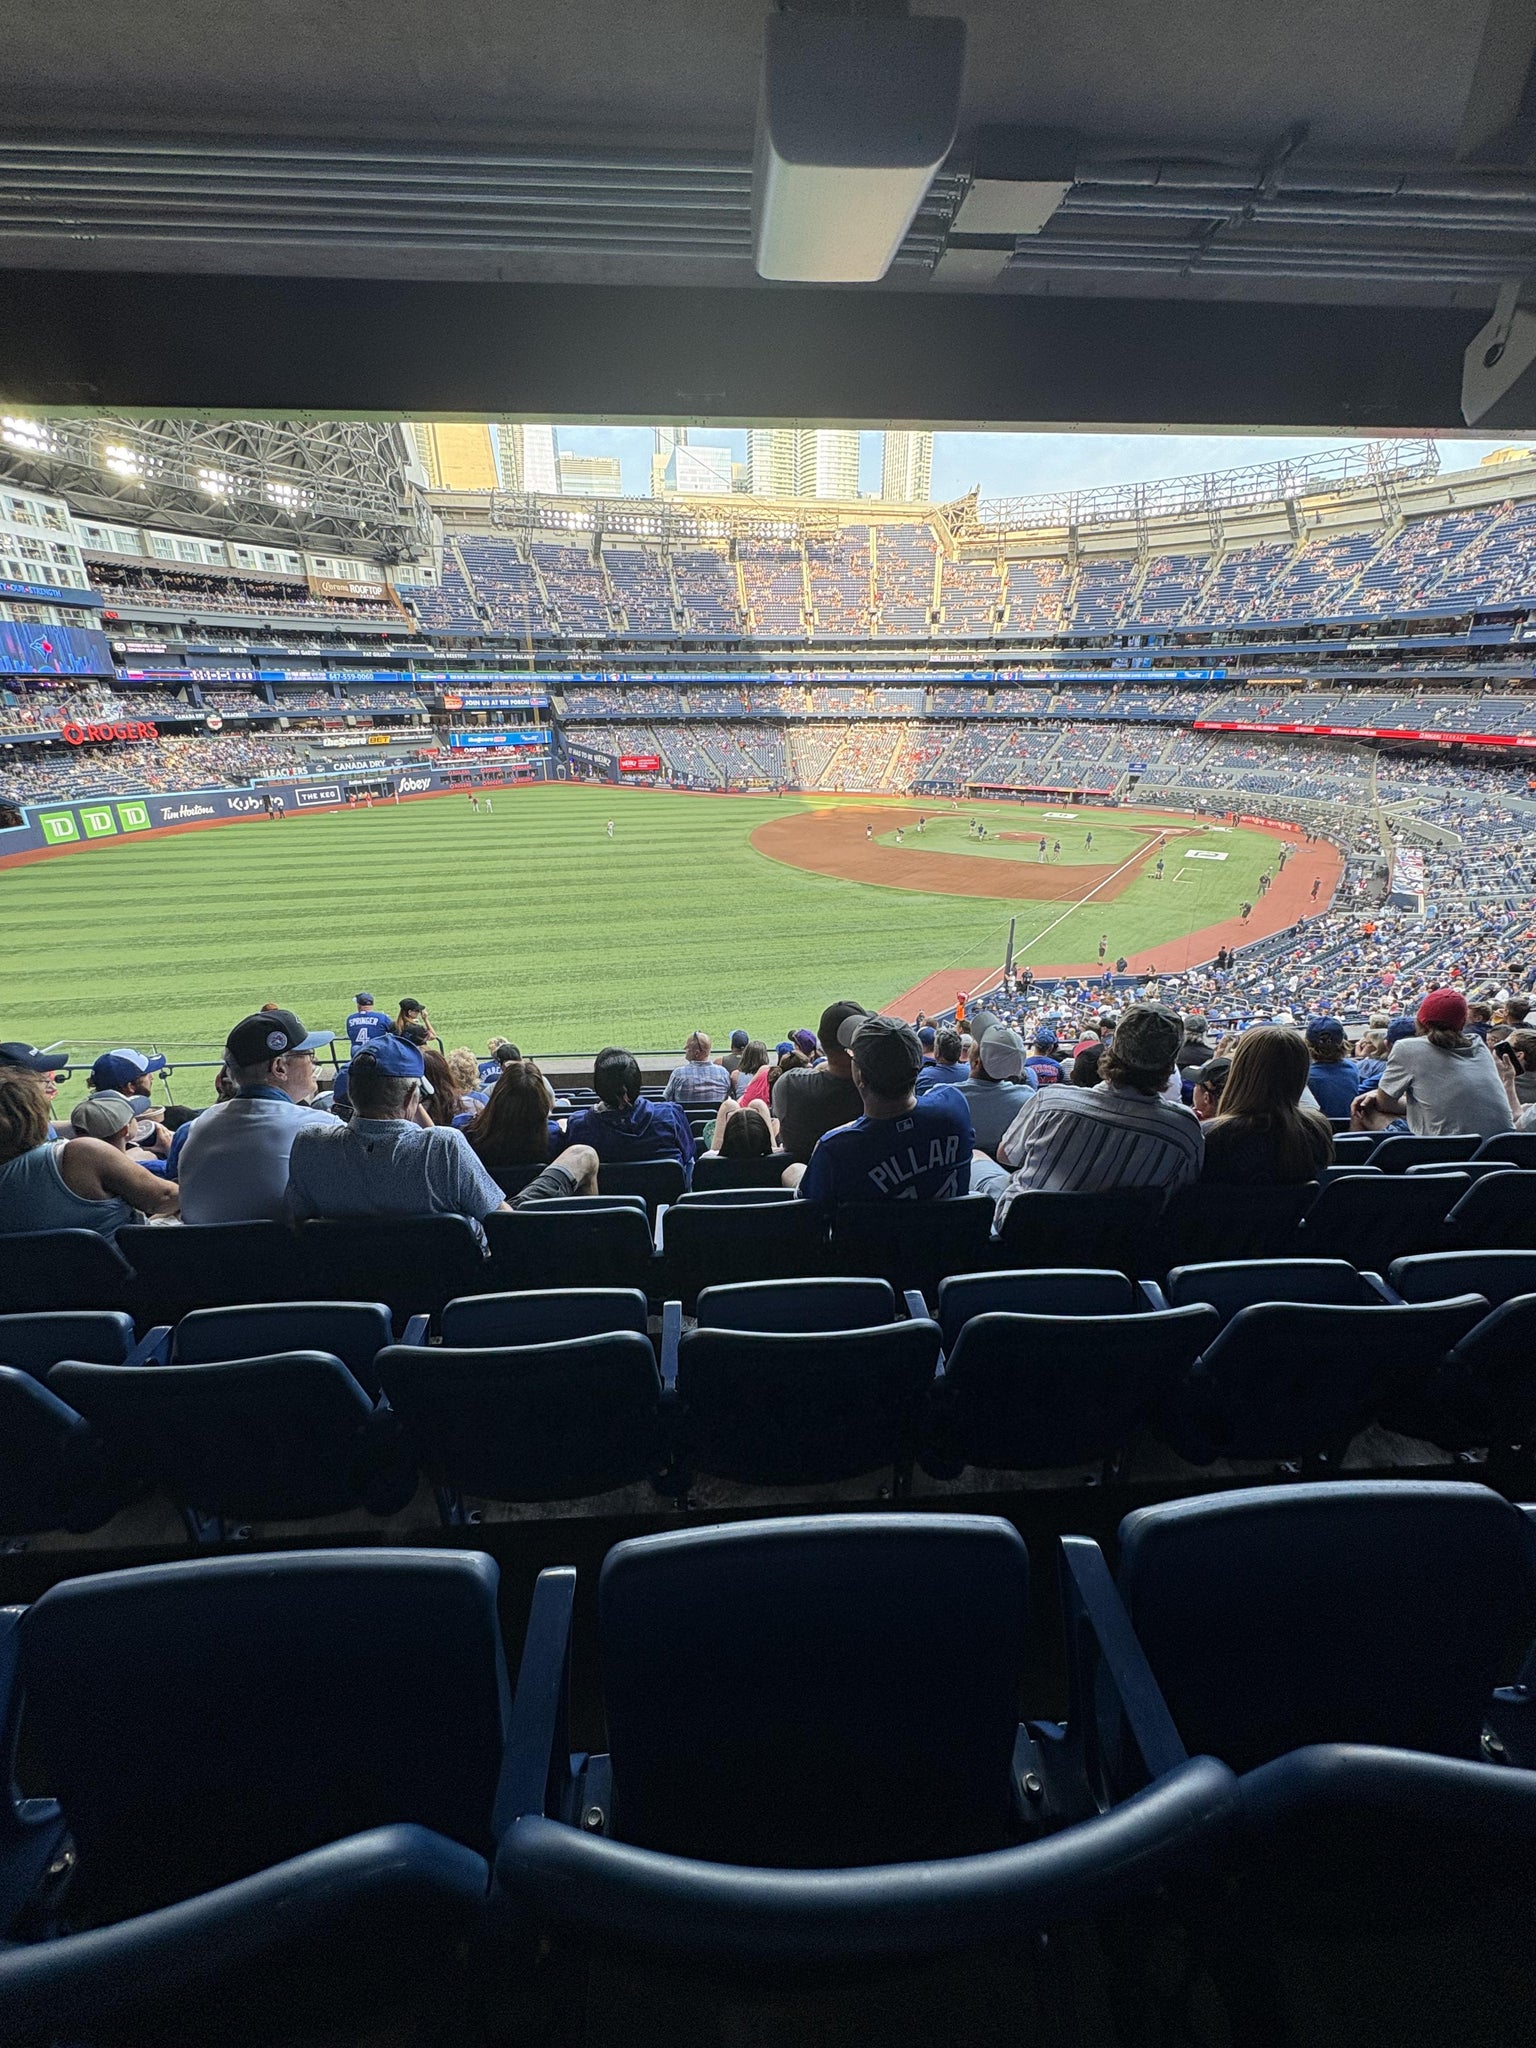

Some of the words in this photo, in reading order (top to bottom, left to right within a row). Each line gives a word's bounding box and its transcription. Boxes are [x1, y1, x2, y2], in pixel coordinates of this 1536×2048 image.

[349, 584, 383, 596] ROOFTOP
[87, 721, 158, 741] ROGERS
[333, 762, 366, 771] CANADA
[369, 760, 386, 768] DRY
[84, 812, 112, 831] TD
[121, 807, 146, 826] TD
[160, 807, 179, 820] Tim
[179, 805, 215, 817] Hortons
[44, 817, 74, 837] TD
[348, 1017, 378, 1027] SPRINGER
[356, 1028, 370, 1046] 4
[868, 1135, 959, 1193] PILLAR
